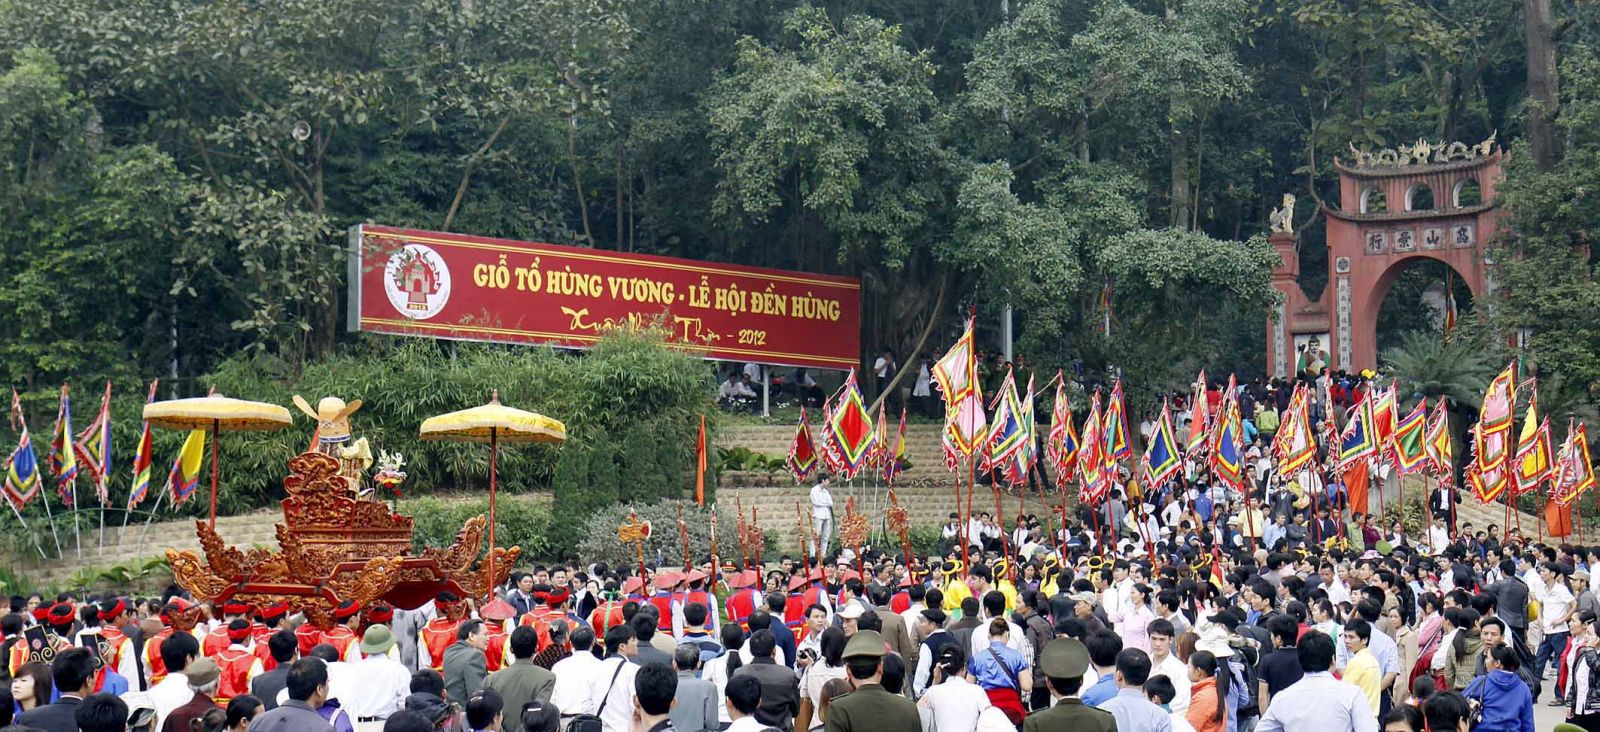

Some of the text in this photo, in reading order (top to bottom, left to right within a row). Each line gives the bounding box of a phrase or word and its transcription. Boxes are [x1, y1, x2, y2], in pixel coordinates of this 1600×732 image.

[473, 253, 511, 289] GIỖ
[515, 256, 542, 292] TỔ
[546, 265, 603, 298] HÙNG
[607, 276, 675, 305] VƯƠNG
[688, 275, 711, 309] LỄ
[715, 283, 747, 316] HỘI
[751, 283, 787, 316] ĐỀN
[791, 291, 841, 322] HÙNG
[738, 329, 766, 345] 2012
